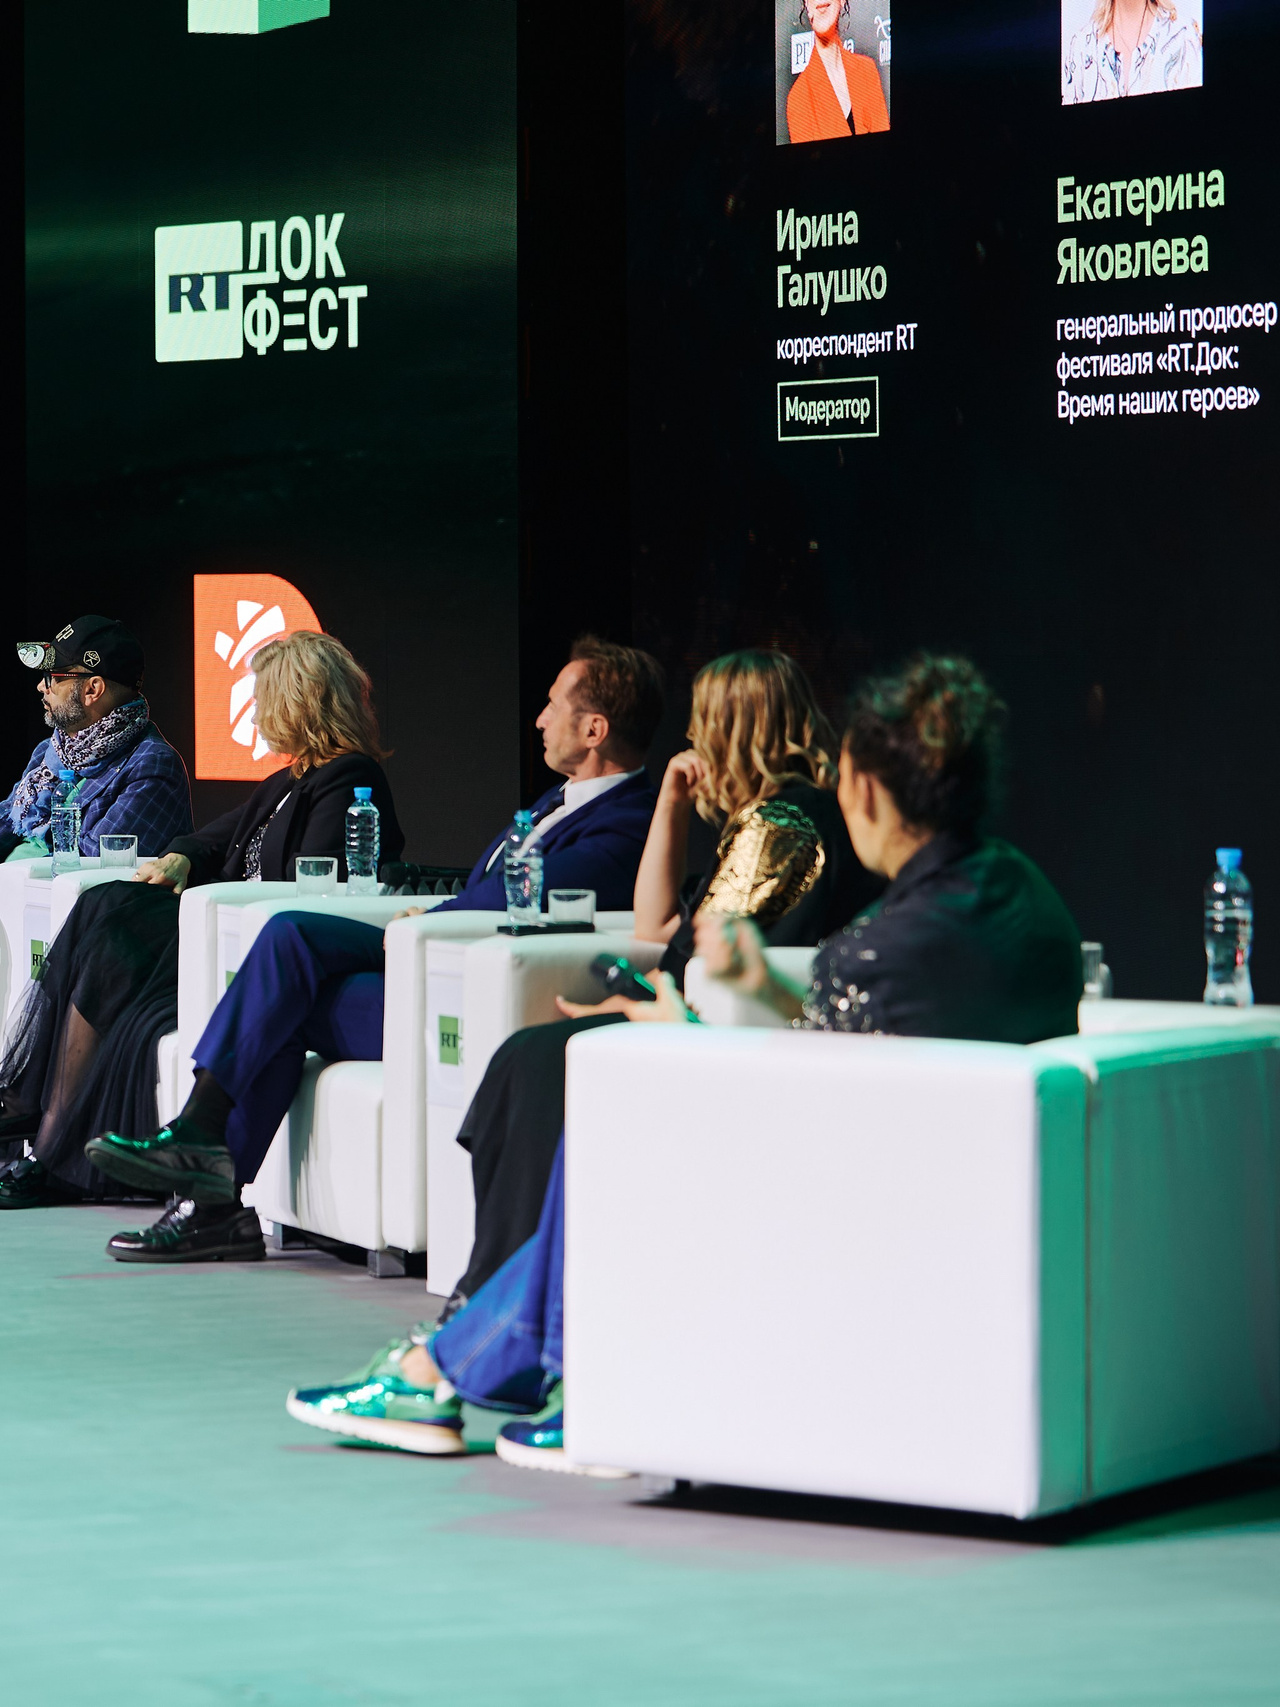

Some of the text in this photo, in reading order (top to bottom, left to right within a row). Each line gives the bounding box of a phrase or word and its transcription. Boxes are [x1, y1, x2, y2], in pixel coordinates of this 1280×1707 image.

[1057, 169, 1225, 226] Екатерина
[243, 213, 346, 284] ДОК
[776, 208, 859, 261] Ирина
[1057, 234, 1209, 284] Яковлева
[168, 270, 242, 314] RT
[777, 264, 888, 316] Галушко
[243, 285, 368, 355] ФЕСТ
[1056, 301, 1278, 345] генеральный продюсер
[777, 323, 918, 365] корреспондент RT
[1056, 341, 1239, 387] фестиваля «RT.Док:
[785, 396, 870, 426] Модератор
[1057, 385, 1261, 424] Время наших героев»
[441, 1032, 459, 1048] RT
